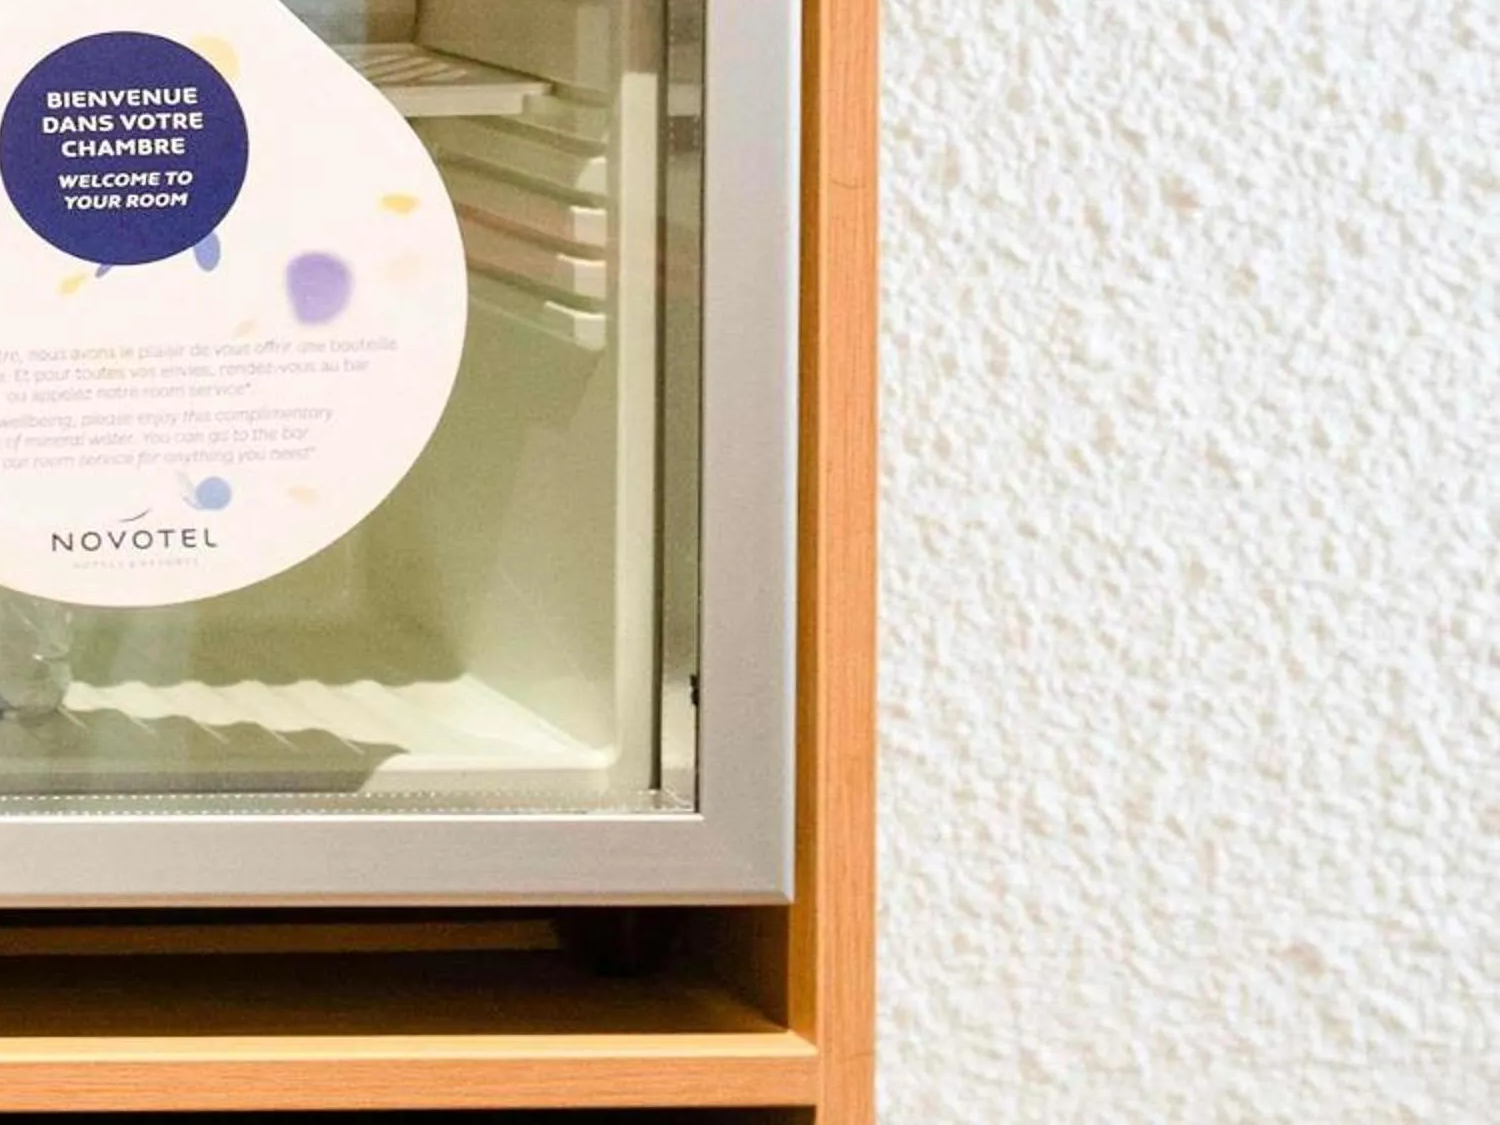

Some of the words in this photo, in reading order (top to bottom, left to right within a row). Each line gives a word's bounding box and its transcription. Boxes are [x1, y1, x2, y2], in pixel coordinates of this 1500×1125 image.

[47, 87, 199, 109] BIENVENUE
[42, 115, 114, 134] DANS
[119, 112, 203, 131] VOTRE
[61, 137, 186, 158] CHAMBRE
[58, 172, 161, 189] WELCOME
[165, 170, 193, 185] TO
[65, 194, 122, 210] YOUR
[125, 192, 188, 208] ROOM
[28, 348, 68, 362] nous
[70, 347, 116, 361] avons
[188, 342, 210, 357] de
[213, 343, 250, 356] vous
[329, 337, 398, 353] bouteille
[14, 368, 31, 383] Et
[34, 368, 71, 384] pour
[73, 366, 125, 381] toutes
[219, 360, 316, 375] rendez-vous
[321, 361, 340, 373] au
[343, 357, 371, 372] bar
[6, 391, 27, 404] ou
[96, 385, 139, 399] notre
[141, 385, 185, 399] room
[137, 412, 178, 429] enjoy
[181, 409, 211, 423] this
[214, 404, 335, 426] complimentary
[5, 432, 22, 453] of
[24, 432, 85, 448] mineral
[143, 430, 171, 444] You
[174, 431, 205, 443] can
[208, 430, 230, 445] go
[232, 428, 249, 442] to
[251, 426, 279, 441] the
[281, 425, 309, 441] bar
[3, 457, 29, 470] our
[33, 455, 75, 469] room
[78, 452, 135, 467] service
[136, 450, 162, 471] for
[163, 448, 234, 467] anything
[237, 449, 266, 465] you
[51, 527, 219, 553] NOVOTEL
